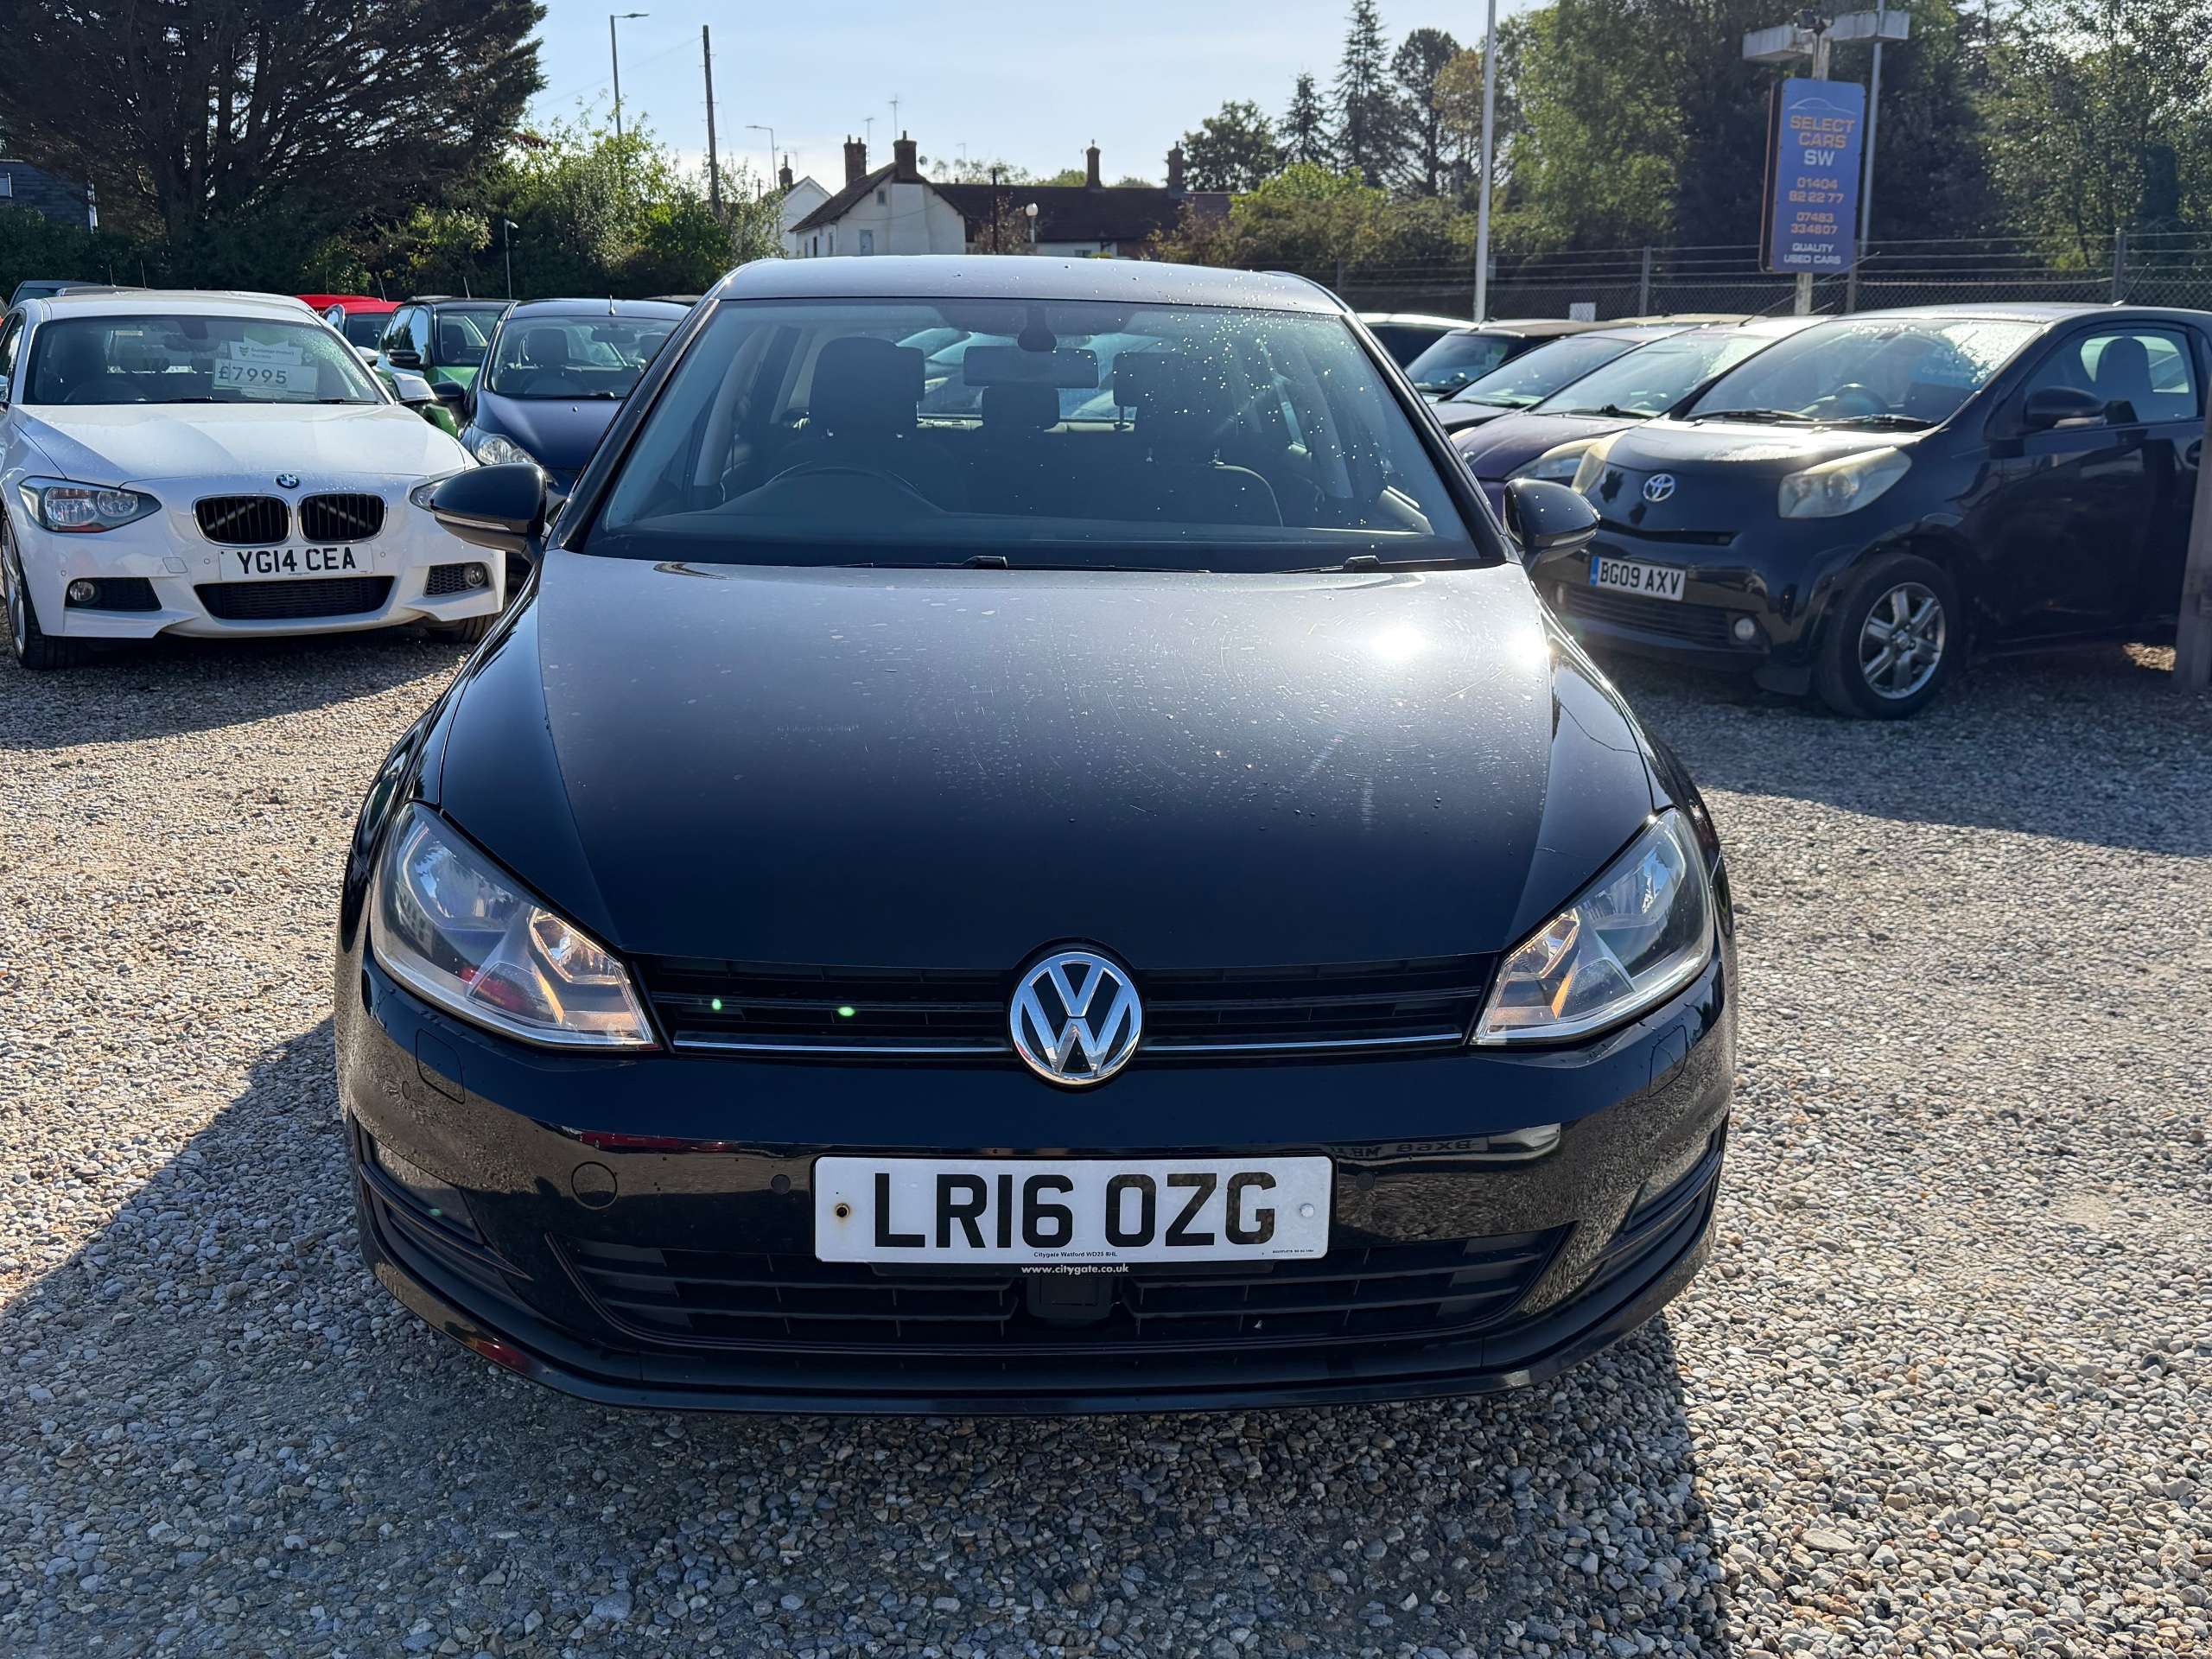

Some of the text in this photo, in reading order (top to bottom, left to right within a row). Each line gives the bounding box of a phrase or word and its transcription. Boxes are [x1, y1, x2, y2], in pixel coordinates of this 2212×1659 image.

[1789, 115, 1856, 133] SELECT
[1798, 131, 1847, 149] CARS
[1803, 149, 1835, 167] SW
[1797, 176, 1839, 189] 01404
[1792, 243, 1834, 253] QUALITY
[1783, 254, 1841, 265] USED CARS
[219, 365, 287, 385] £7995
[237, 546, 356, 575] YG14 CEA
[1599, 562, 1641, 588] BG09
[1644, 569, 1681, 594] AXV
[874, 1172, 1277, 1249] LR16 OZG
[1021, 1263, 1129, 1275] www.citygate.co.uk
